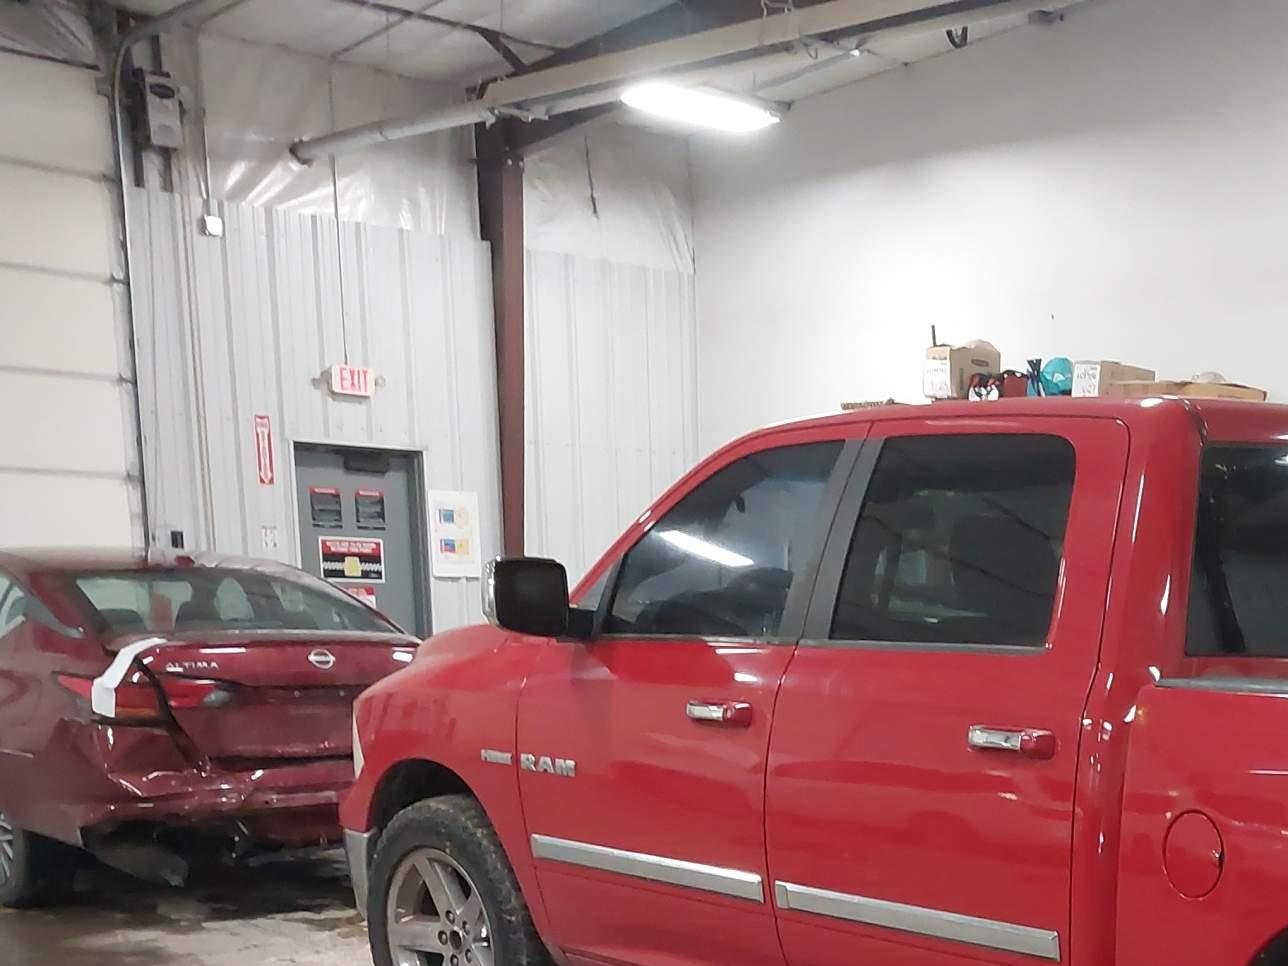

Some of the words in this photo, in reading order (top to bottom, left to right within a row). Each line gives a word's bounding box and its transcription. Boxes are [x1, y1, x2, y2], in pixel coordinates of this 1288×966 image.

[339, 367, 368, 393] EXIT
[165, 661, 219, 672] ALTIMA
[520, 752, 576, 777] RAM
